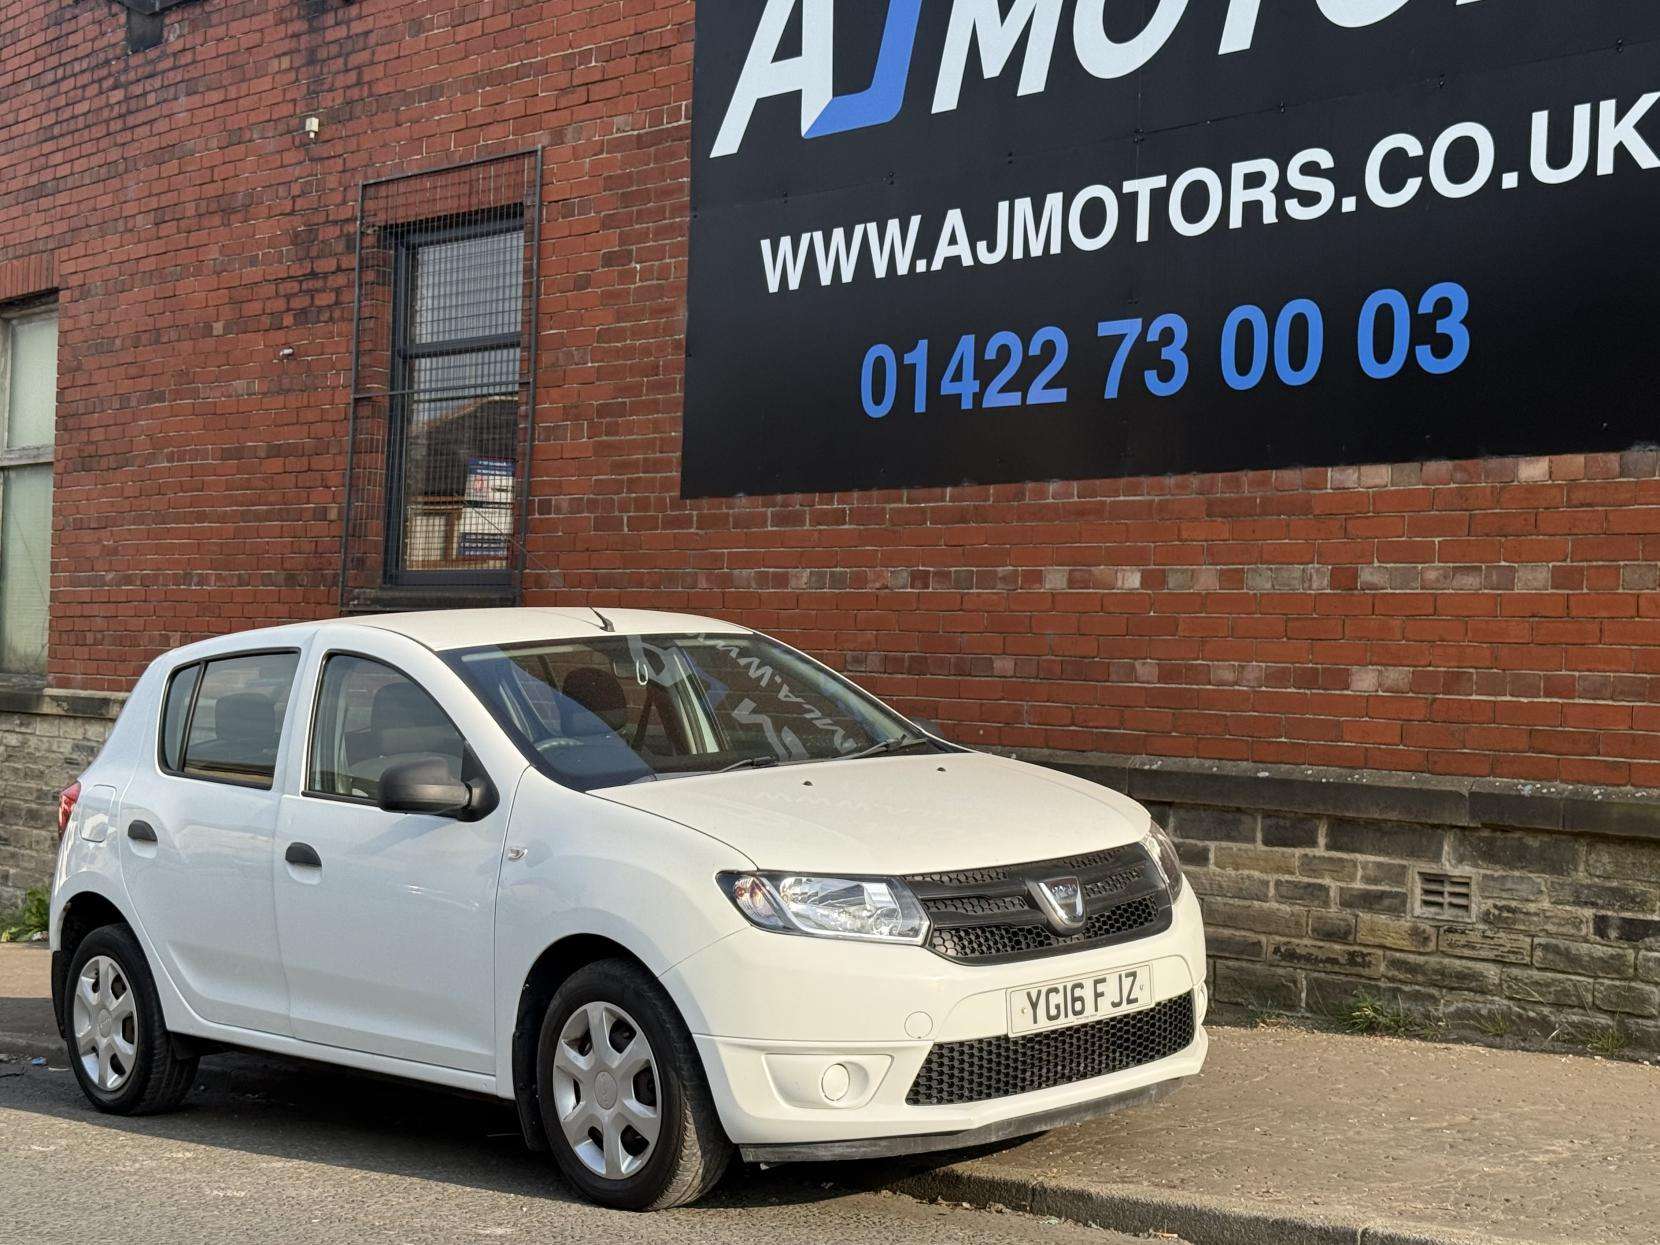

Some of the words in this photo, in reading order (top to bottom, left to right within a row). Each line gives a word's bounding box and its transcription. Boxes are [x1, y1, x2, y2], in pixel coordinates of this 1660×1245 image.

[761, 92, 1660, 293] WWW.AJMOTORS.CO.UK
[860, 326, 1069, 418] 01422
[1098, 313, 1189, 399] 73
[1221, 298, 1324, 391] 00
[1357, 281, 1470, 379] 03
[1026, 982, 1086, 1025] YG16
